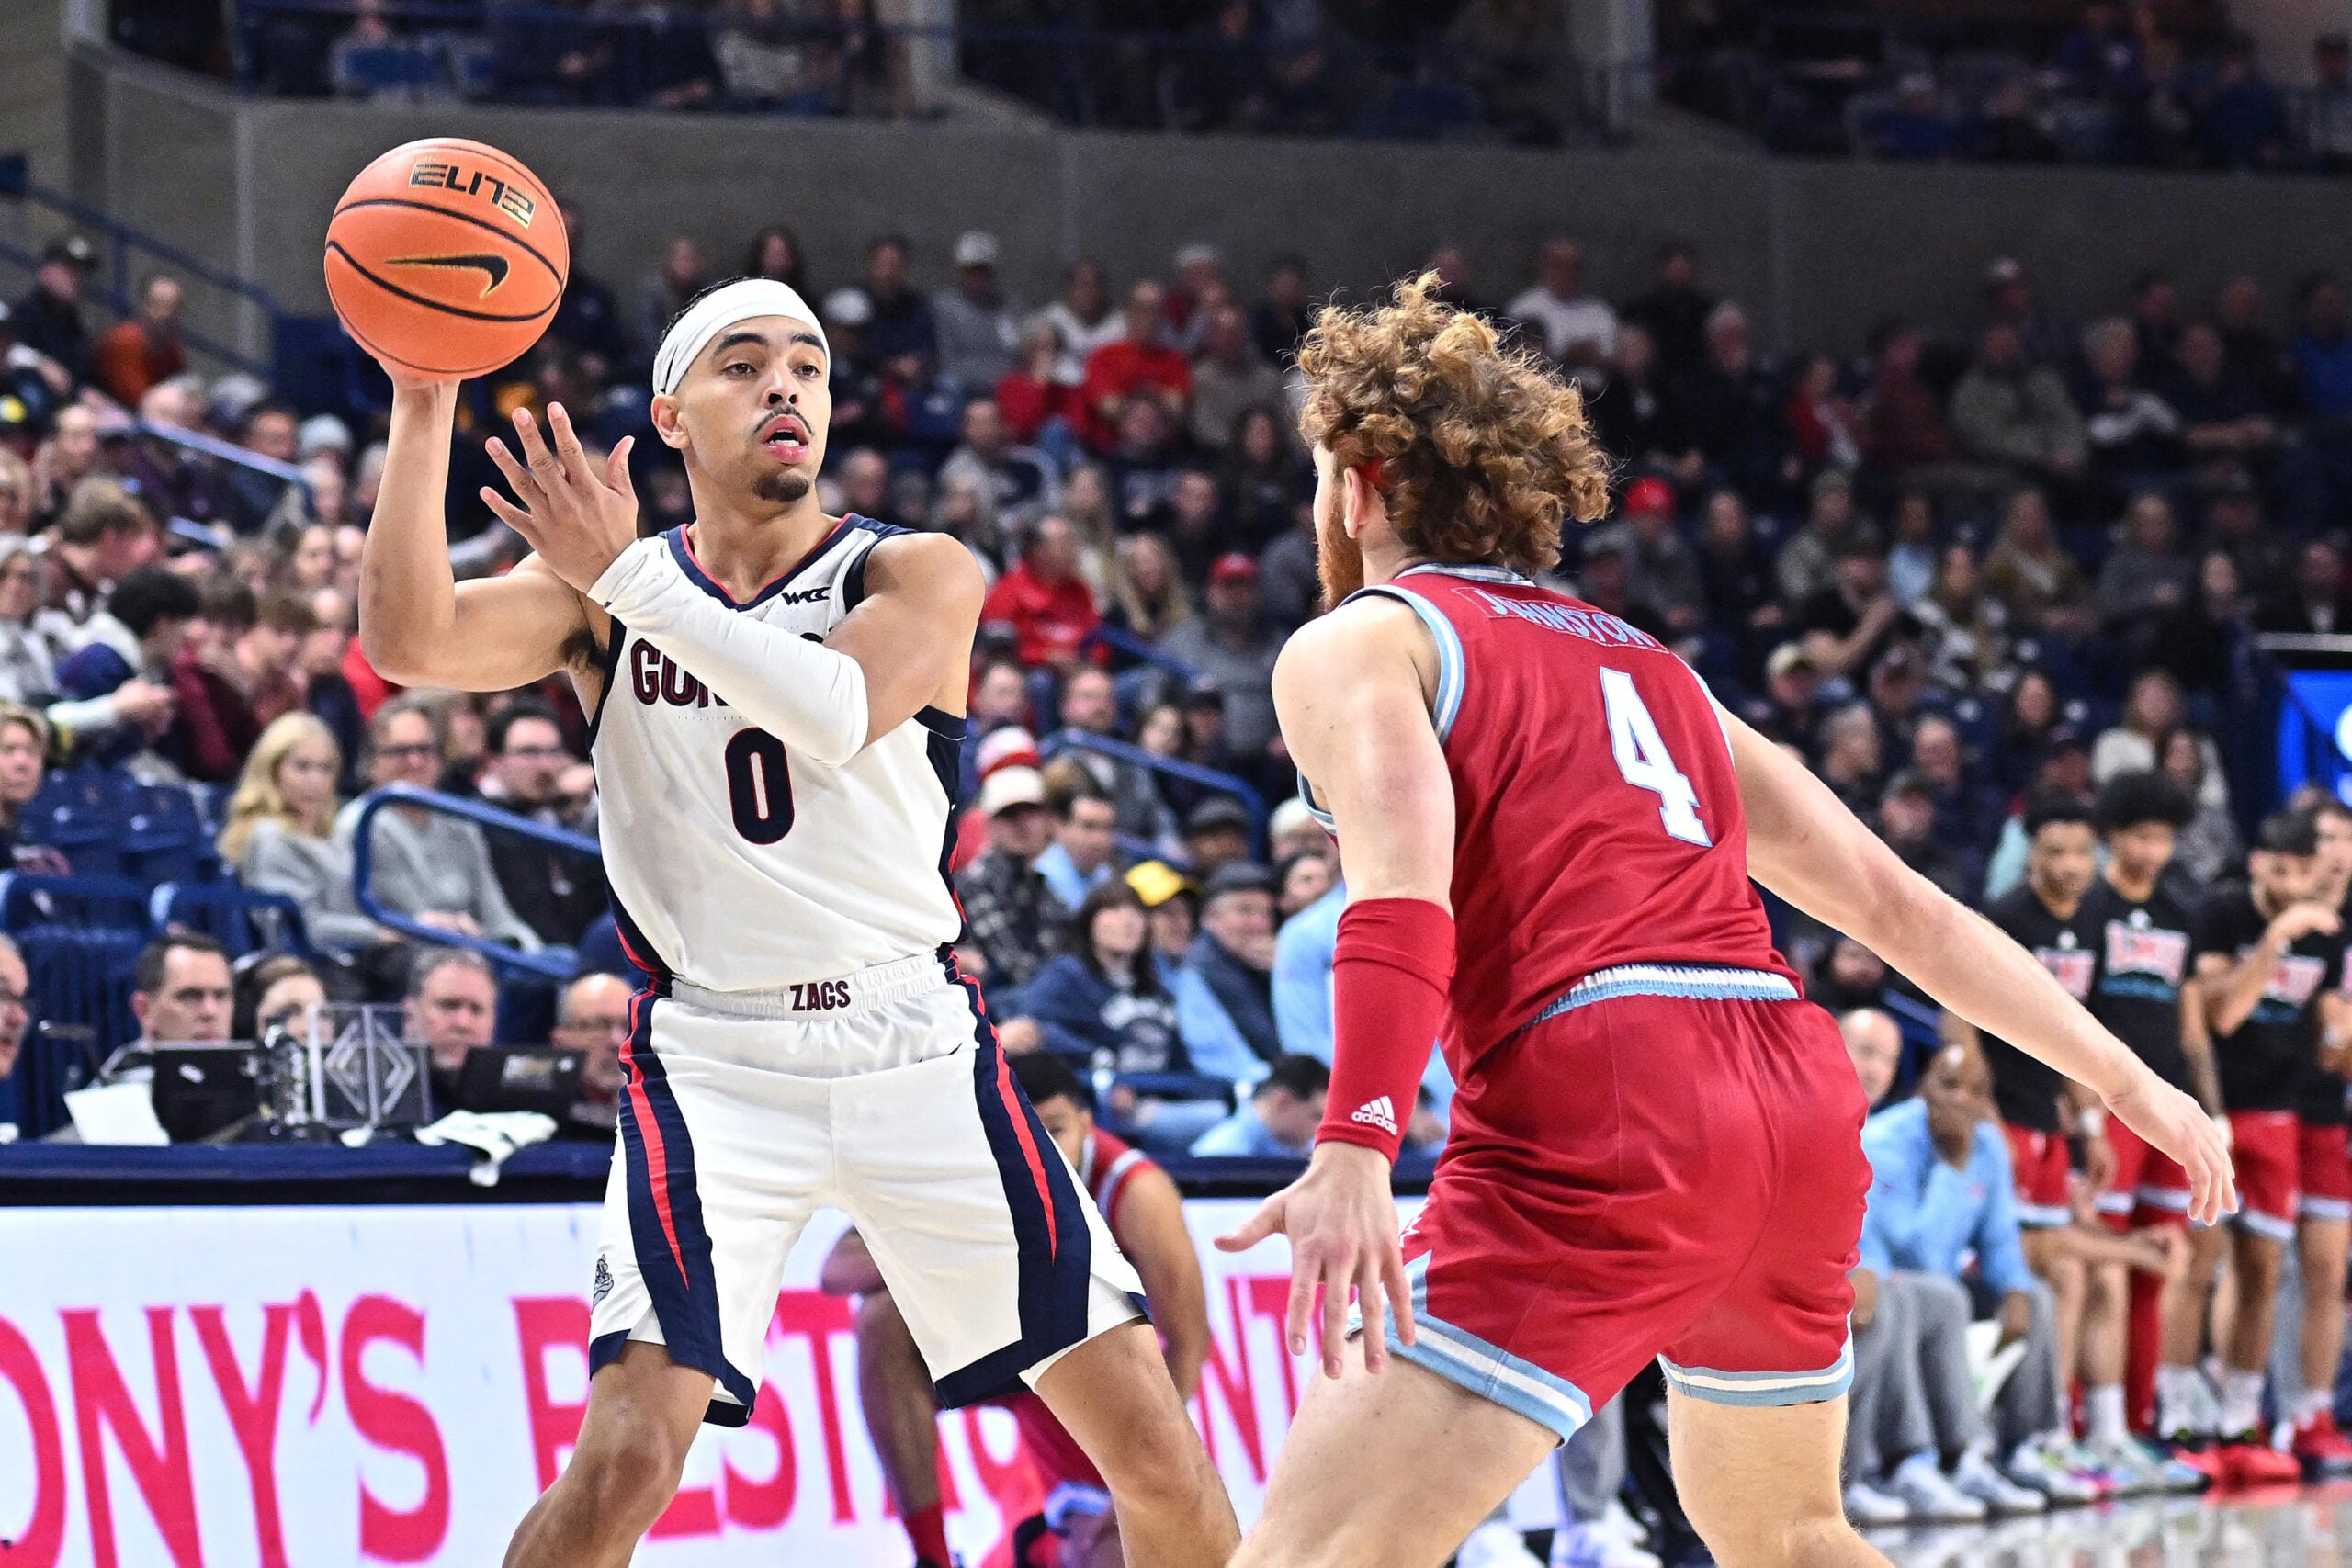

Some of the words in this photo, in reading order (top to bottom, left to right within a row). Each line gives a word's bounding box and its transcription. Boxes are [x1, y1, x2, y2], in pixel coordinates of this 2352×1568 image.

[409, 162, 536, 229] ELITE
[724, 727, 795, 845] 0
[1600, 666, 1713, 847] 4
[789, 980, 851, 1011] ZAGS
[1351, 1111, 1397, 1136] adidas
